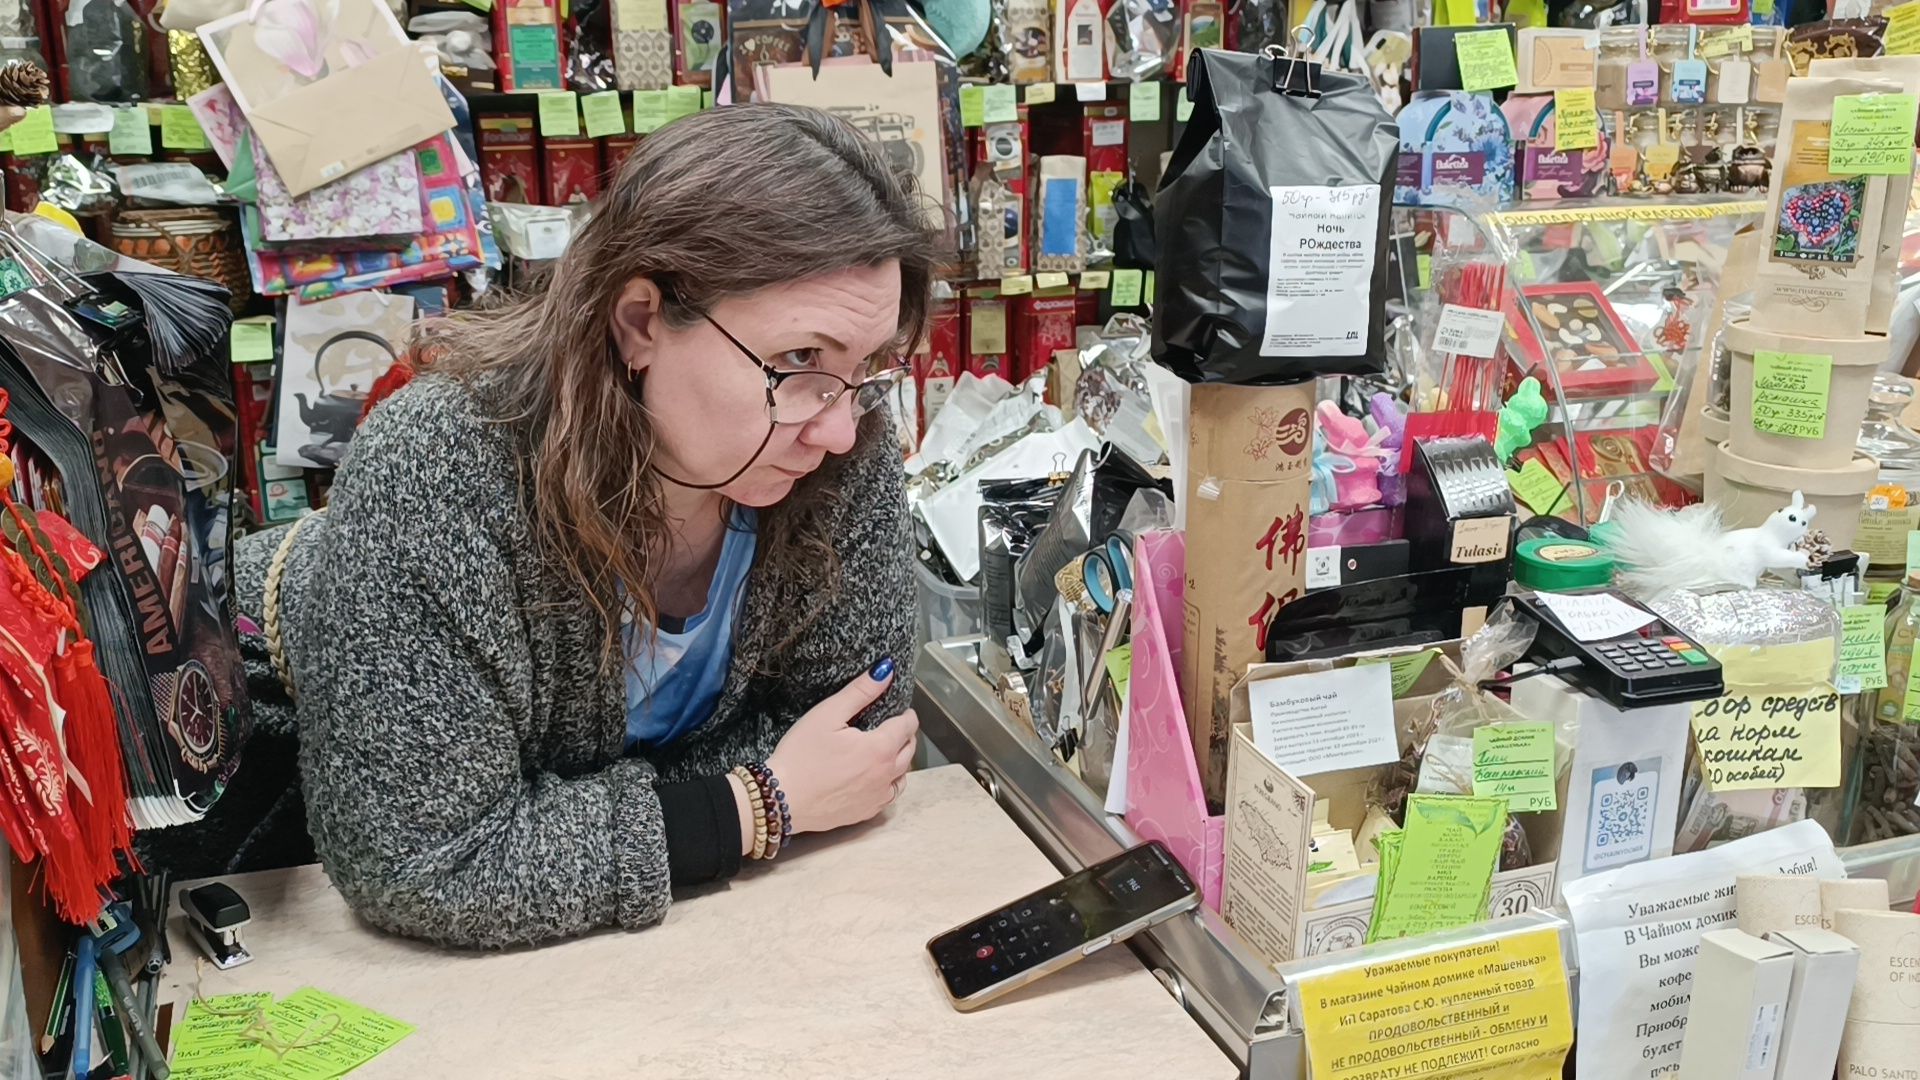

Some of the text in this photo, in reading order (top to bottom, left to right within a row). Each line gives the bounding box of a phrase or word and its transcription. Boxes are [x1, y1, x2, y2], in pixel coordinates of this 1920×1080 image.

[1317, 224, 1345, 233] Ночь
[1299, 238, 1362, 250] РОждества
[1799, 425, 1819, 435] РУБ
[1866, 676, 1883, 685] РУБ
[1270, 691, 1338, 708] Бамбуковый чай
[1761, 693, 1839, 721] средств
[1731, 724, 1801, 746] корм
[1726, 762, 1785, 783] особей)
[1530, 797, 1551, 807] РУБ
[1628, 890, 1711, 919] Уважаемые
[1624, 909, 1739, 945] В Чайном домик
[1364, 941, 1500, 978] Уважаемые покупатели!
[1639, 954, 1660, 969] Вы
[1320, 955, 1546, 1009] В магазине Чайном домике «Машенька»
[1659, 971, 1692, 987] кофе
[1890, 971, 1905, 983] OF
[1340, 978, 1535, 1028] ИП Саратова С.Ю. купленный товар
[1650, 994, 1691, 1012] мобил
[1369, 1002, 1510, 1040] ПРОДОВОЛЬСТВЕННЫЙ и
[1636, 1015, 1688, 1037] Приобр
[1331, 1058, 1345, 1069] НЕ
[1348, 1026, 1481, 1066] ПРОДОВОЛЬСТВЕННЫЙ
[1489, 1017, 1538, 1035] ОБМЕНУ
[1540, 1014, 1548, 1026] И
[1642, 1040, 1682, 1060] будет
[1404, 1062, 1418, 1075] НЕ
[1421, 1047, 1488, 1070] ПОДЛЕЖИТ!
[1490, 1038, 1540, 1056] Согласно
[1849, 1063, 1919, 1080] PALO SANTO
